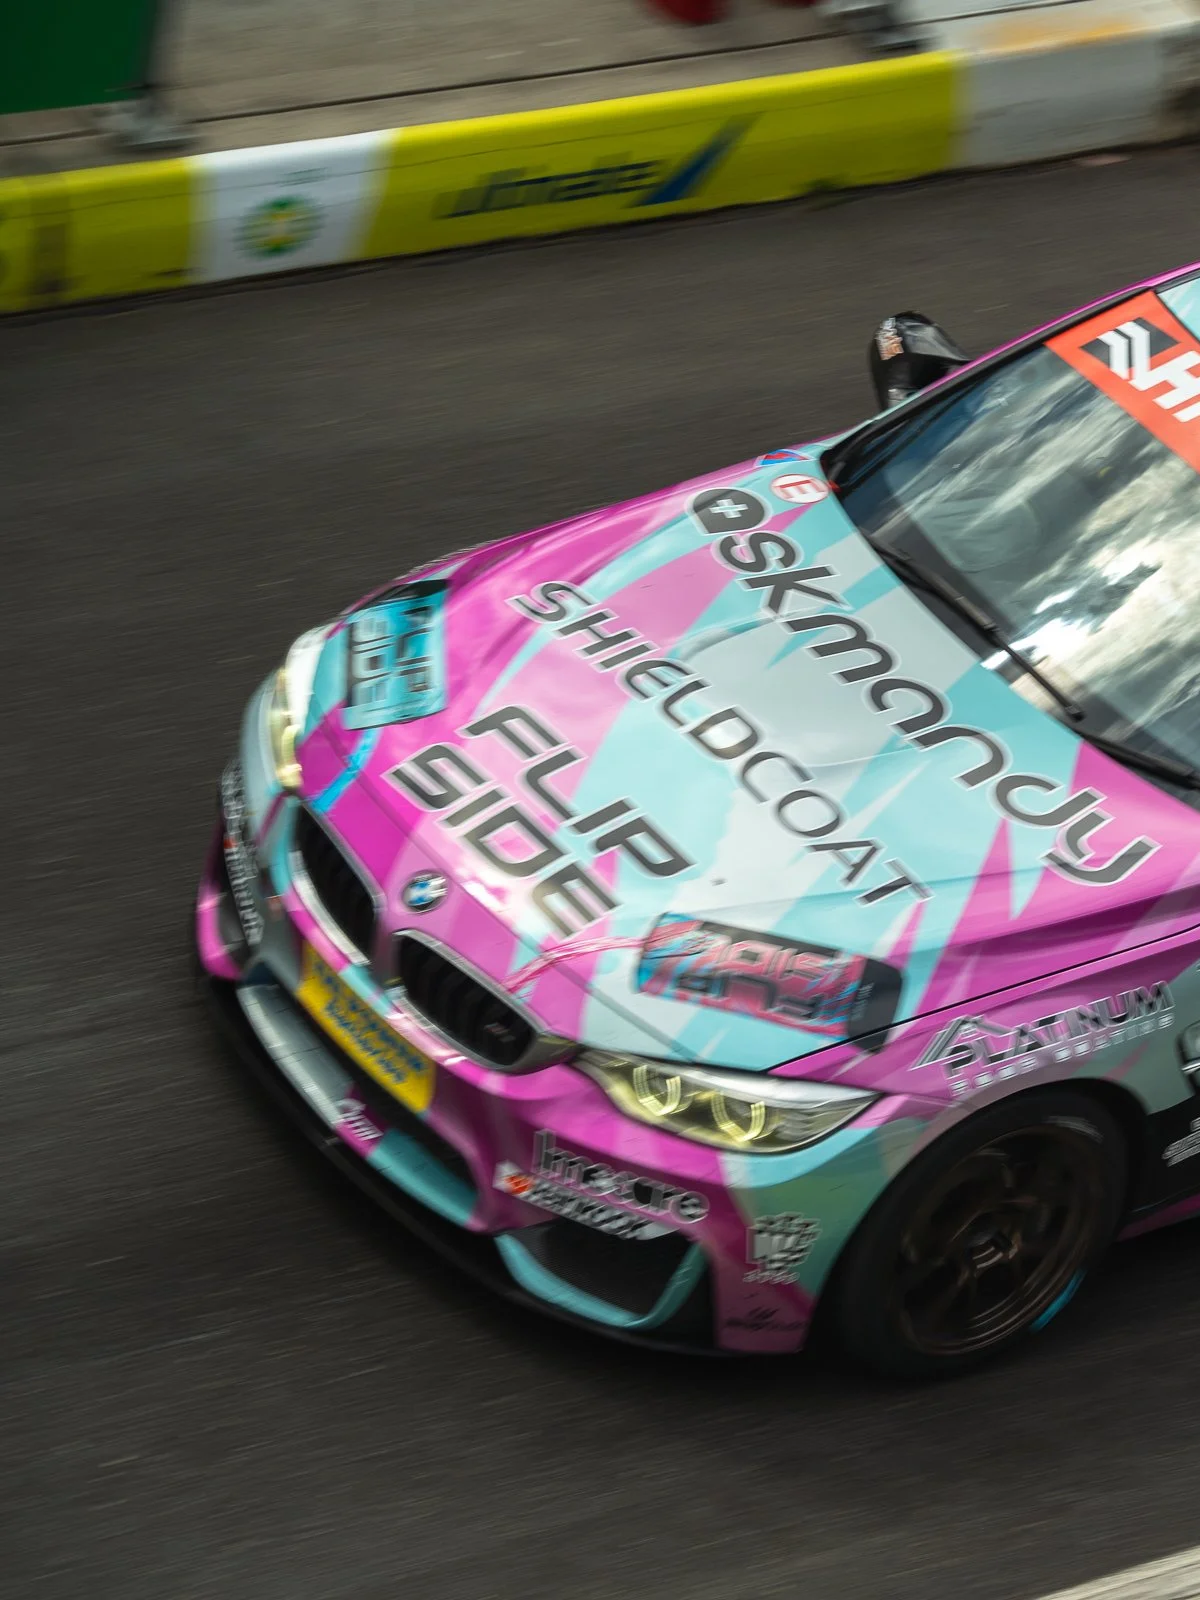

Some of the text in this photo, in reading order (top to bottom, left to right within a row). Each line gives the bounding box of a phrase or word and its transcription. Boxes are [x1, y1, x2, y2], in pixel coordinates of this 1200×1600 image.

[455, 705, 697, 878] FLIP
[505, 580, 934, 906] SHIELDCOAT
[381, 742, 625, 941] SIDE
[941, 980, 1175, 1080] PLATINUM
